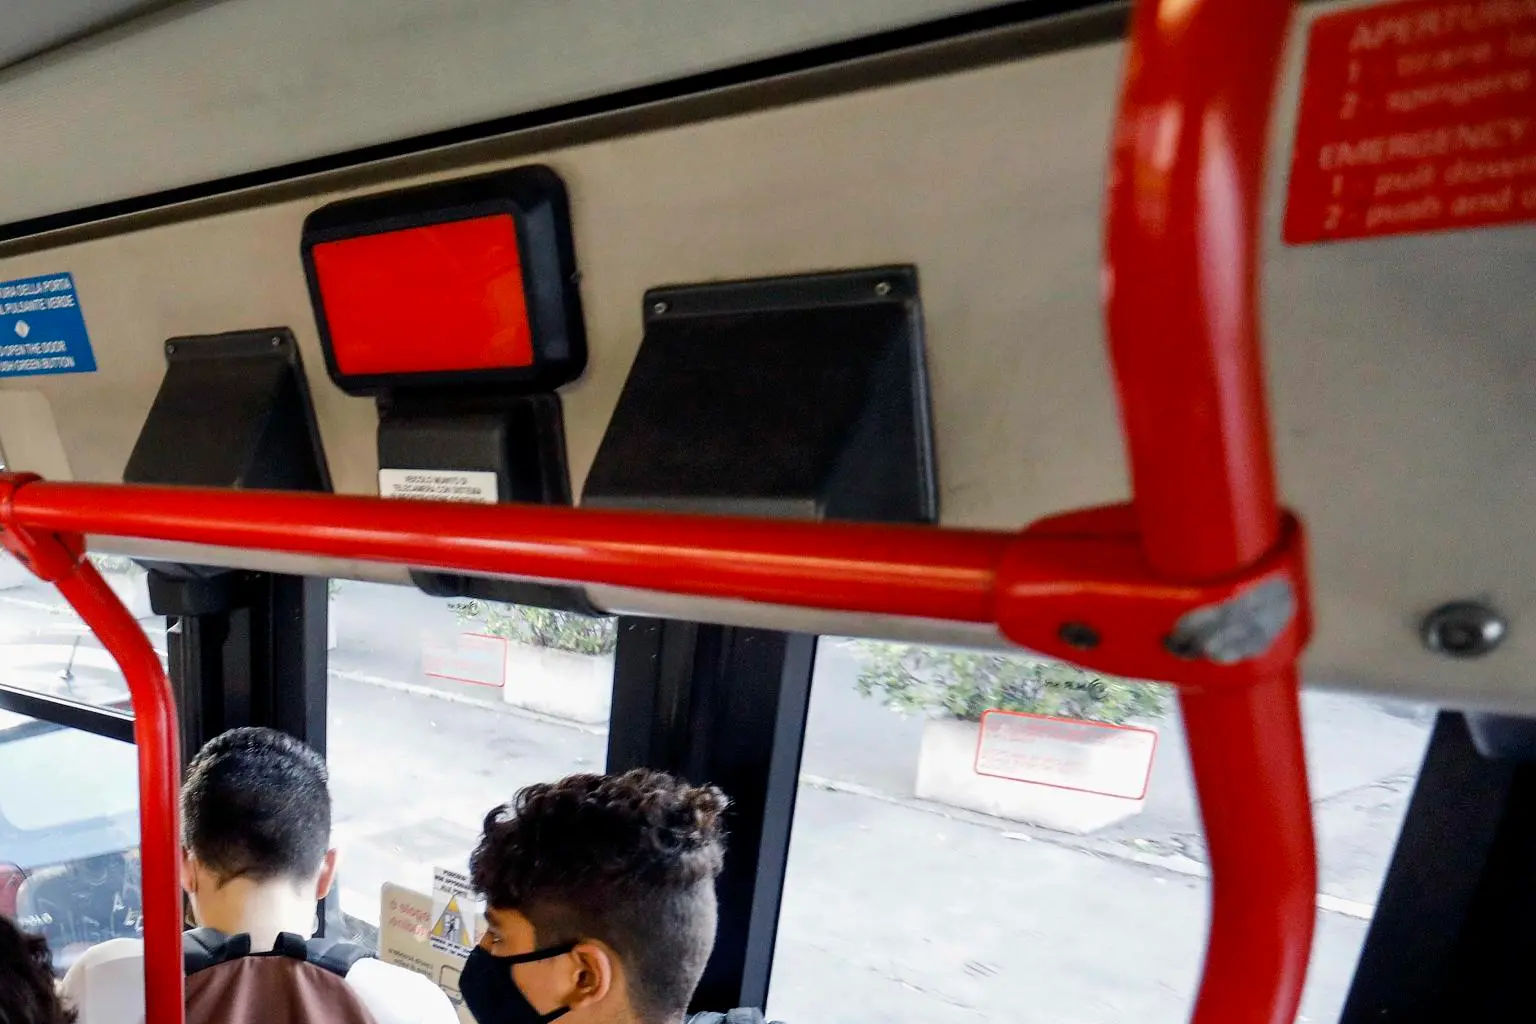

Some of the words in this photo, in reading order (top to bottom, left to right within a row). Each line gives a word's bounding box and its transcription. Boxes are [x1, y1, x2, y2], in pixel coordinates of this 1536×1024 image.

[1318, 116, 1530, 171] EMERGENCY
[1374, 162, 1437, 198] pull
[1365, 193, 1444, 231] push
